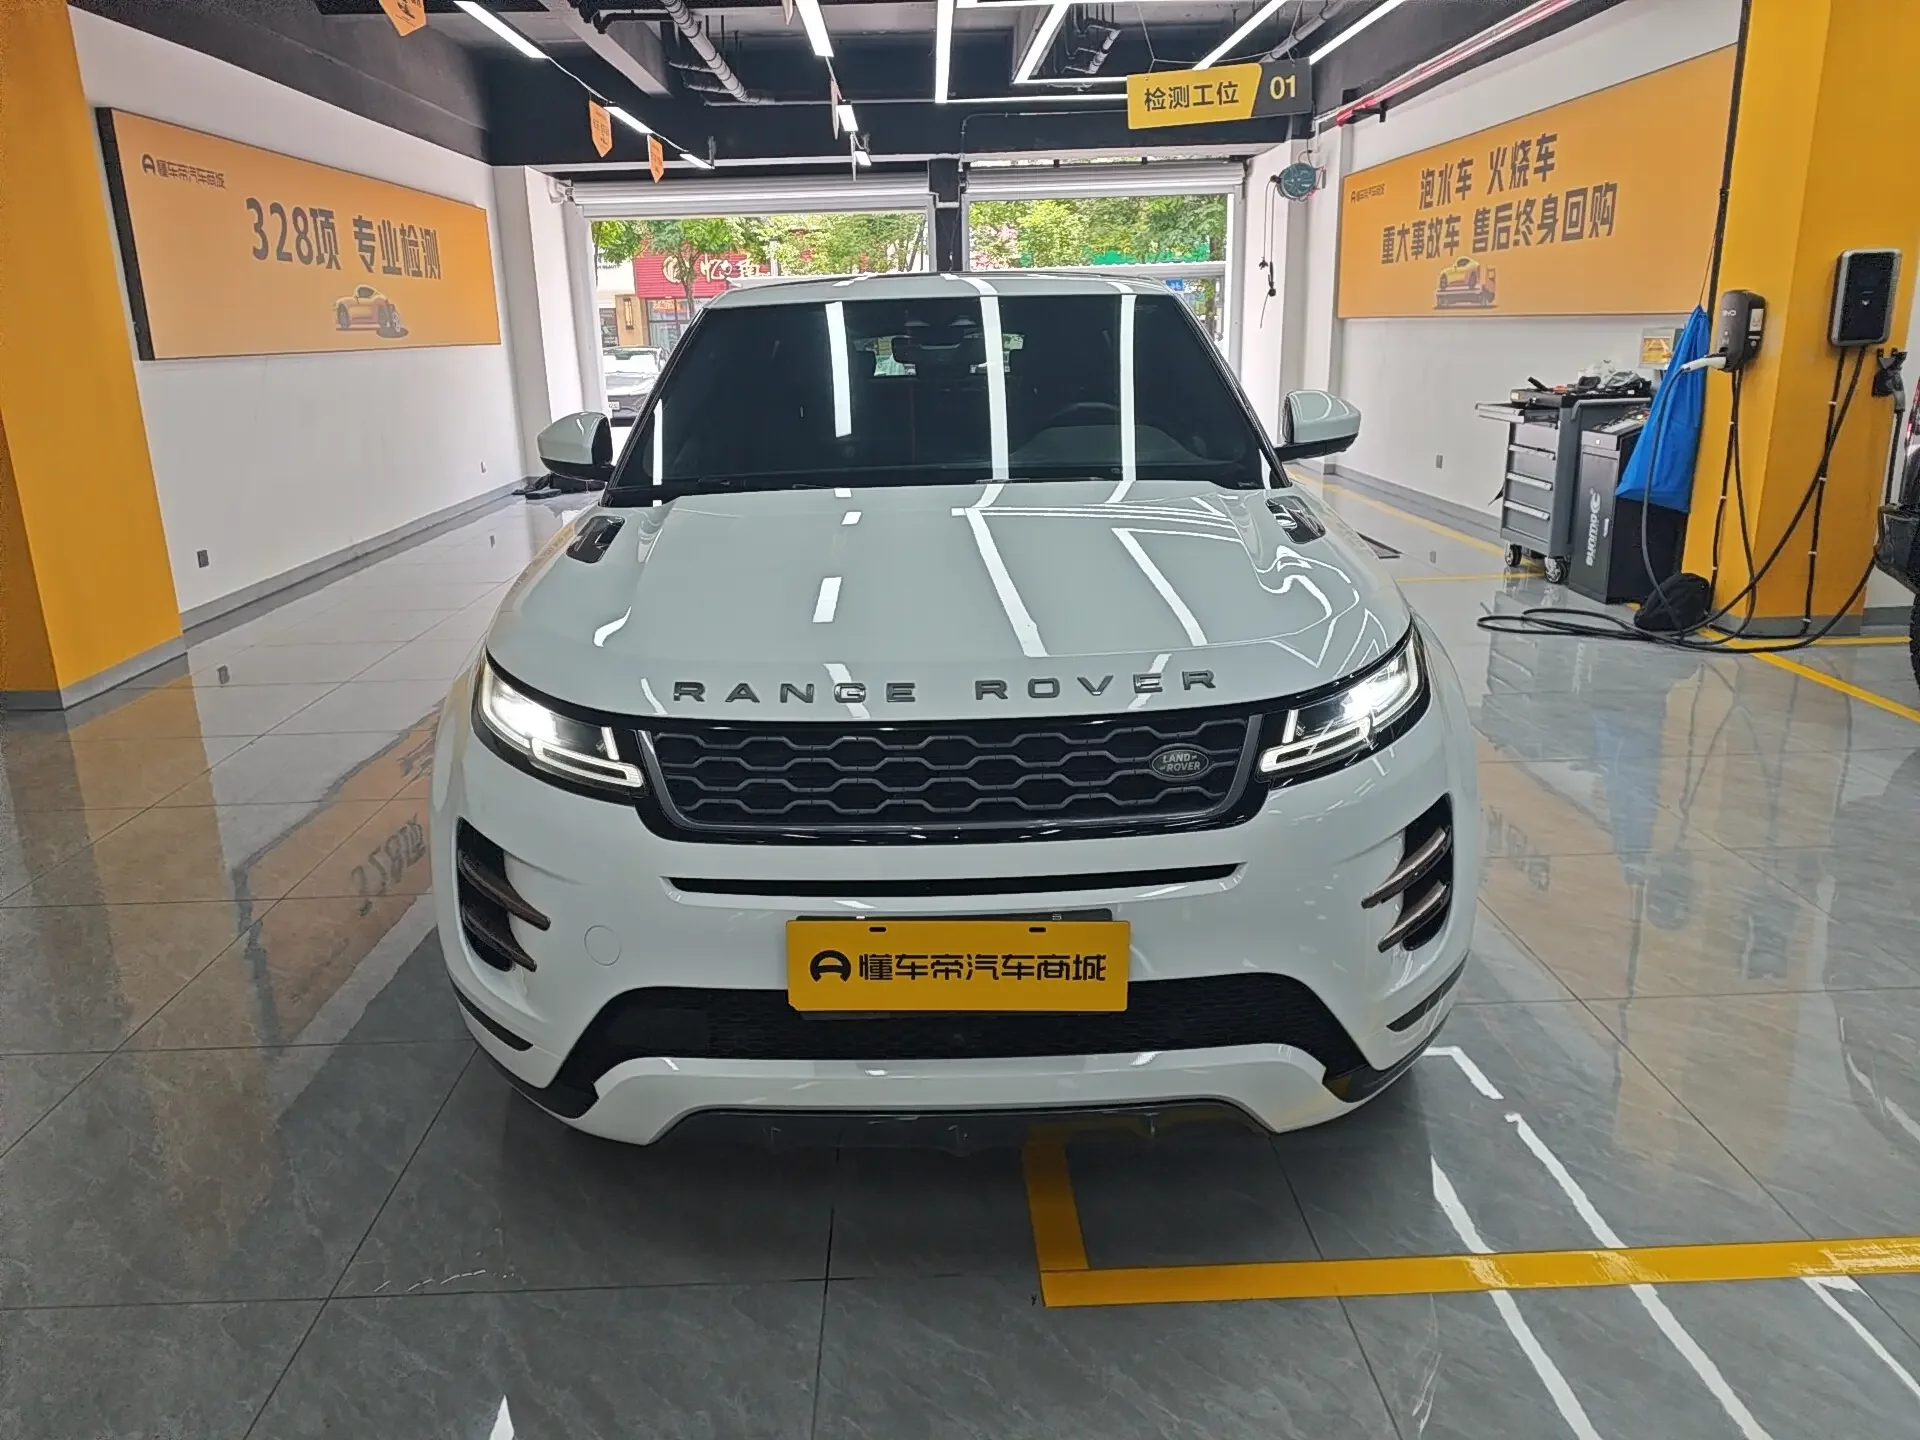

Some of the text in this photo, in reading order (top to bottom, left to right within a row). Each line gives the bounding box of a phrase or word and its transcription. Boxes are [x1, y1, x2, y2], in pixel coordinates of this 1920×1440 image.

[1144, 75, 1297, 112] 检测工位 01
[1419, 133, 1558, 210] 泡水车 火烧车
[246, 197, 441, 280] 328项 专业检测
[1381, 182, 1618, 264] 重大事故车 售后终身回购
[672, 669, 1217, 704] RANGE ROVER
[1162, 753, 1191, 763] LAND
[1166, 762, 1201, 772] ROVER
[858, 953, 1107, 982] 懂车帝汽车商城
